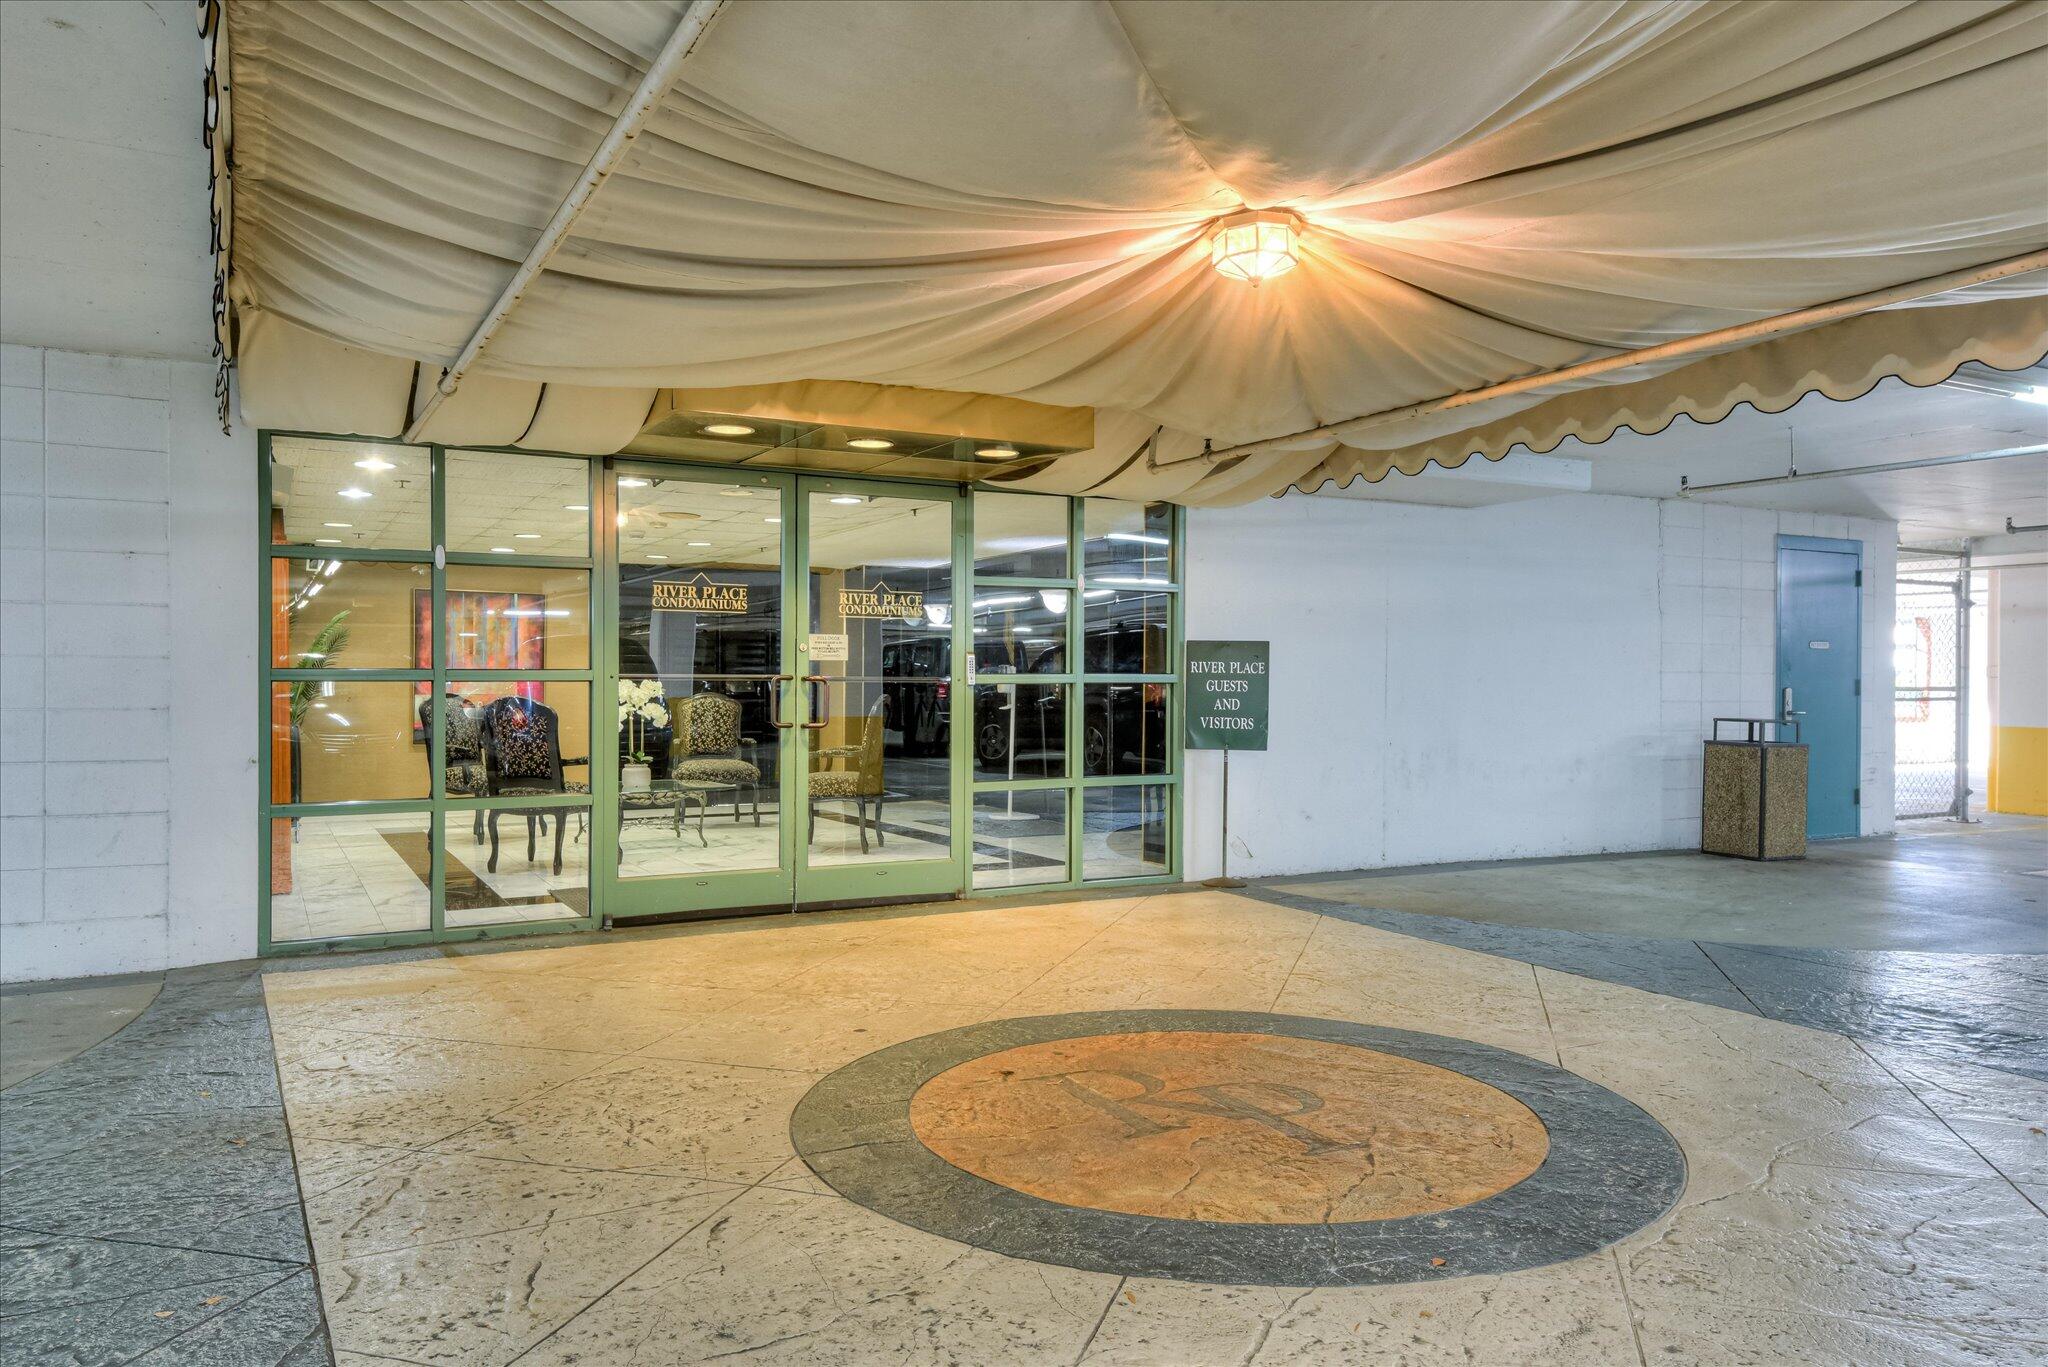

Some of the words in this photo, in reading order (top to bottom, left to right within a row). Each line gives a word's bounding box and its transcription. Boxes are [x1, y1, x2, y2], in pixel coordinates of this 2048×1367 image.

[652, 584, 696, 599] RIVER
[703, 586, 748, 600] PLACE
[652, 597, 748, 611] CONDOMINIUMS
[839, 592, 878, 606] RIVER
[883, 594, 923, 606] PLACE
[838, 604, 923, 616] CONDOMINIUMS
[1190, 661, 1226, 673] RIVER
[1230, 662, 1265, 674] PLACE
[1206, 679, 1248, 692] GUESTS
[1213, 698, 1240, 710] AND
[1200, 717, 1254, 730] VISITORS
